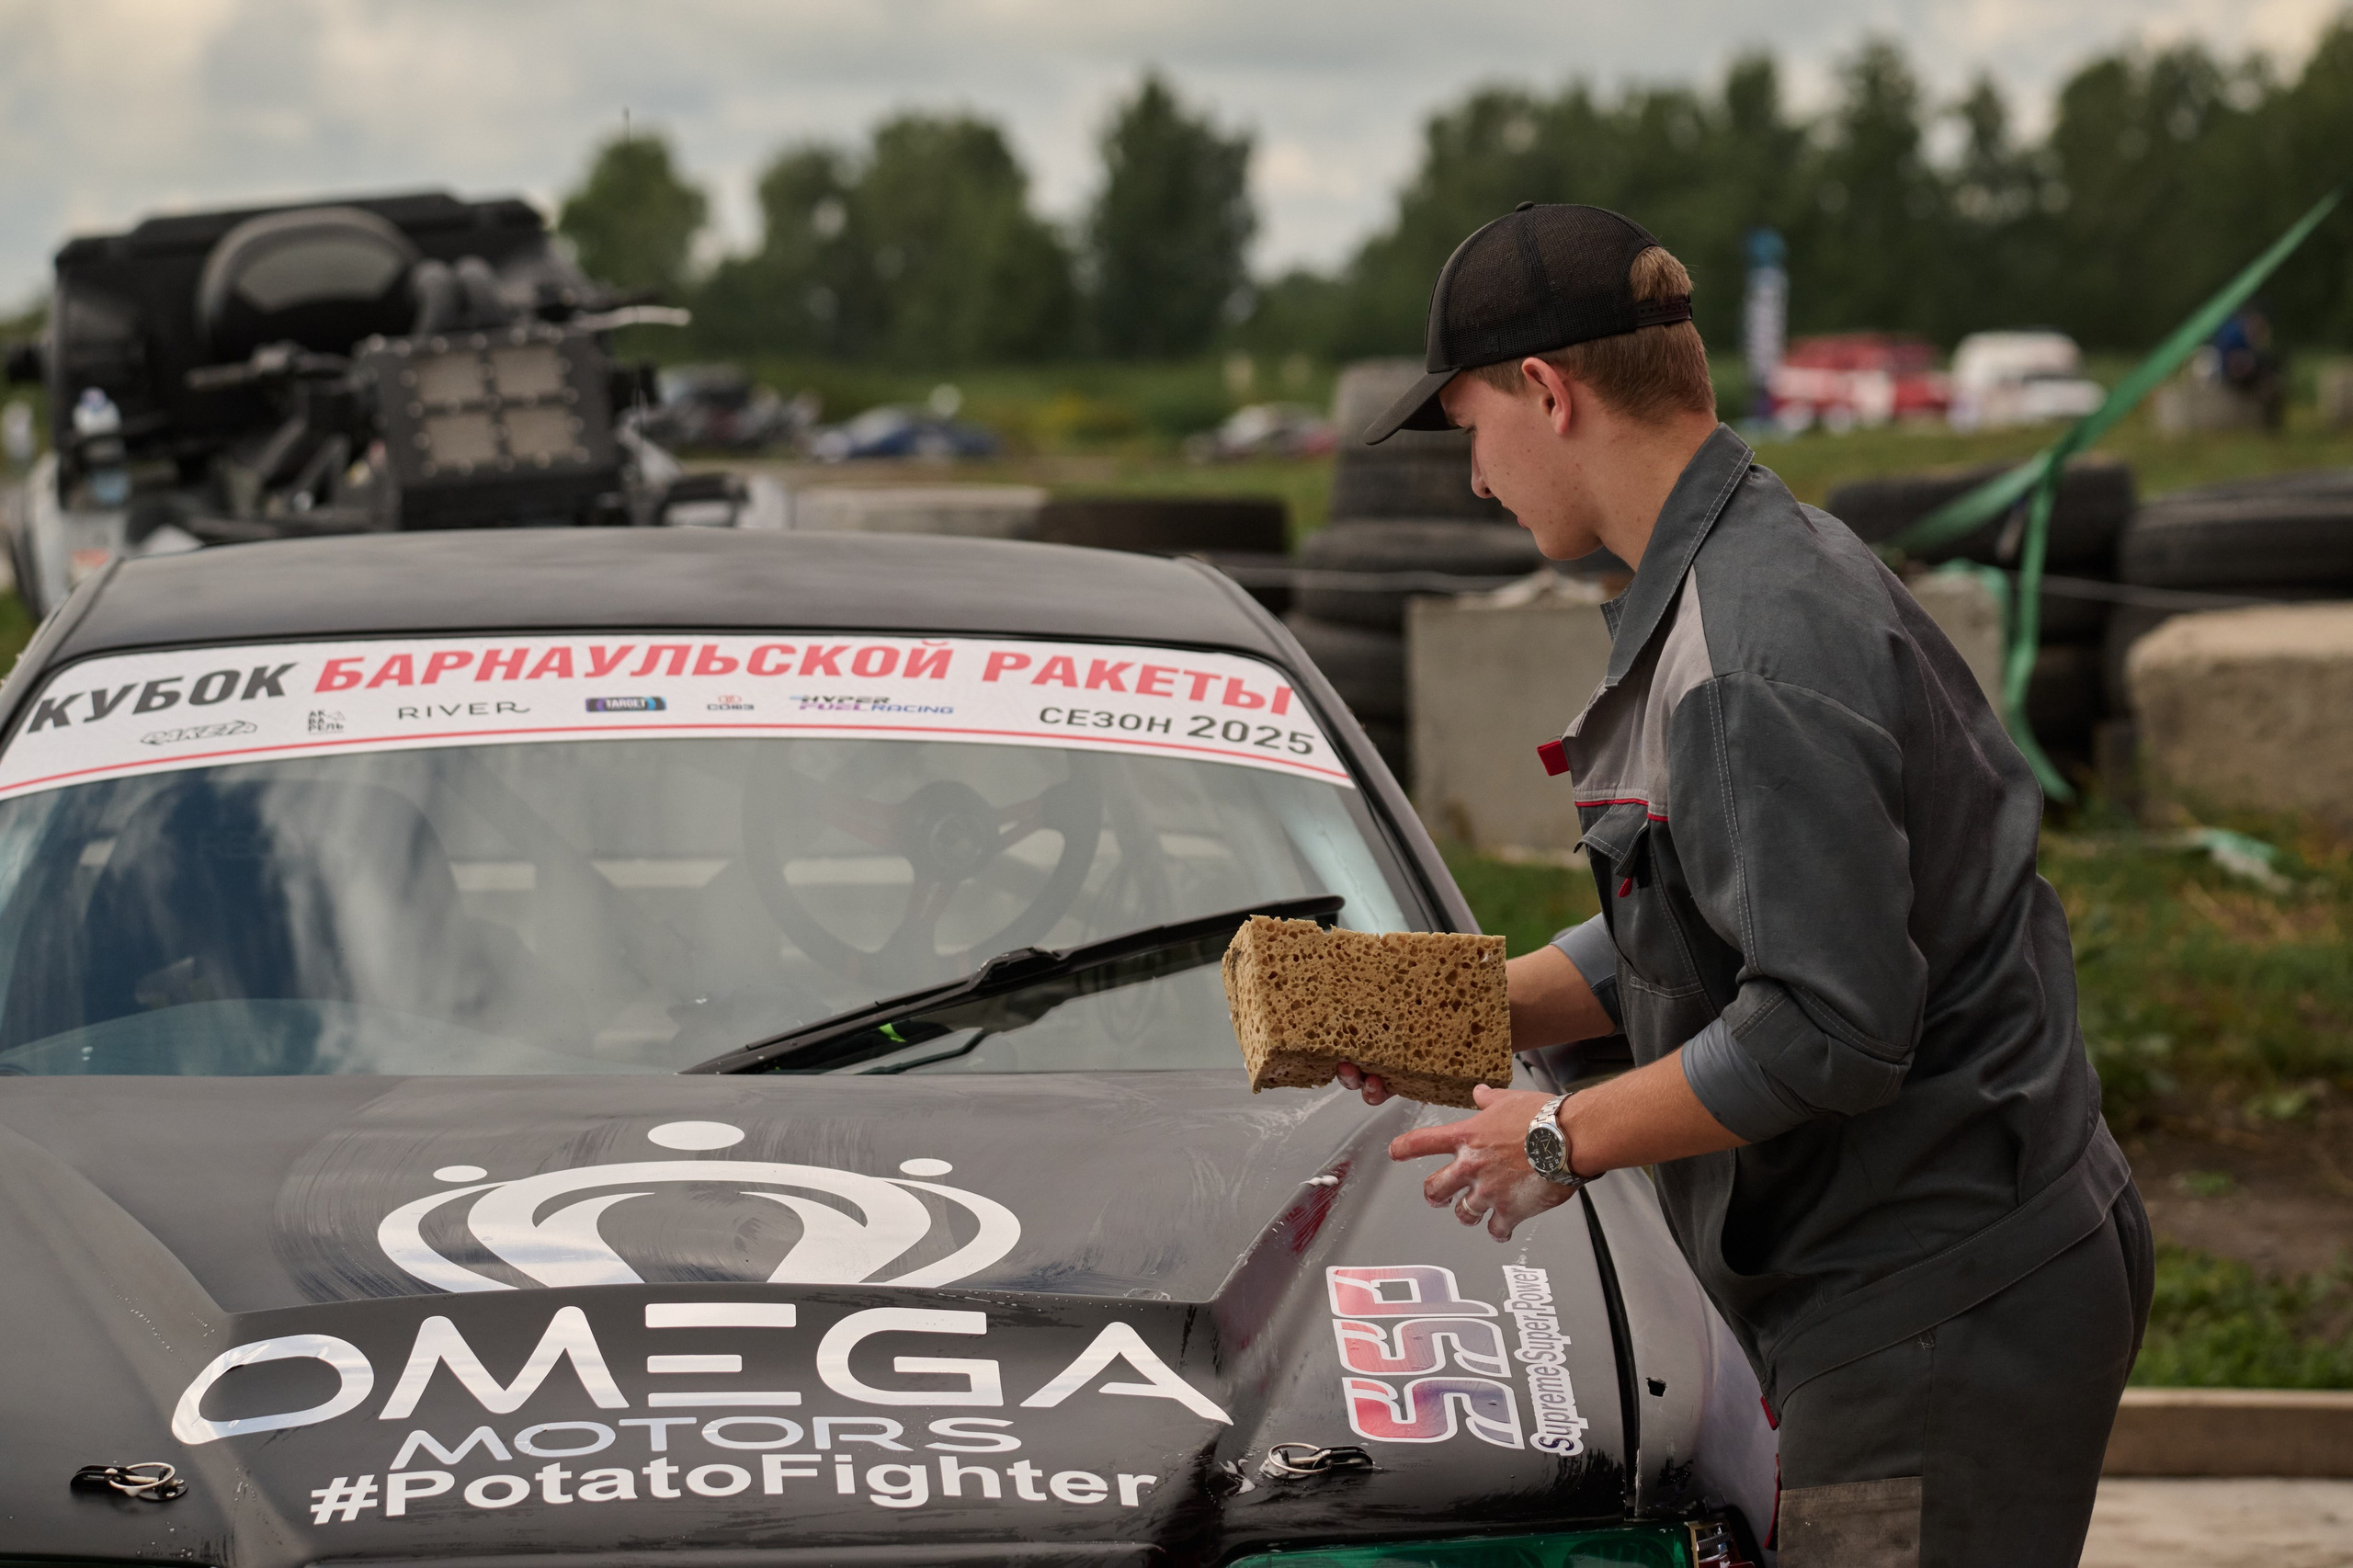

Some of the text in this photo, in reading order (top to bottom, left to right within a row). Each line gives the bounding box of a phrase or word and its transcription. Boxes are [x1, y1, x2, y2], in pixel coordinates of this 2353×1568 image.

[28, 641, 1294, 733] КУБОК БАРНАУЛЬСКОЙ РАКЕТЫ
[397, 702, 531, 720] RIVER
[801, 696, 890, 704] HYPER
[1039, 707, 1315, 756] СЕЗОН 2025
[172, 1302, 1233, 1445] OMEGA
[1326, 1265, 1526, 1449] SSP
[390, 1416, 1022, 1471] MOTORS
[311, 1454, 1157, 1525] #PotatoFighter
